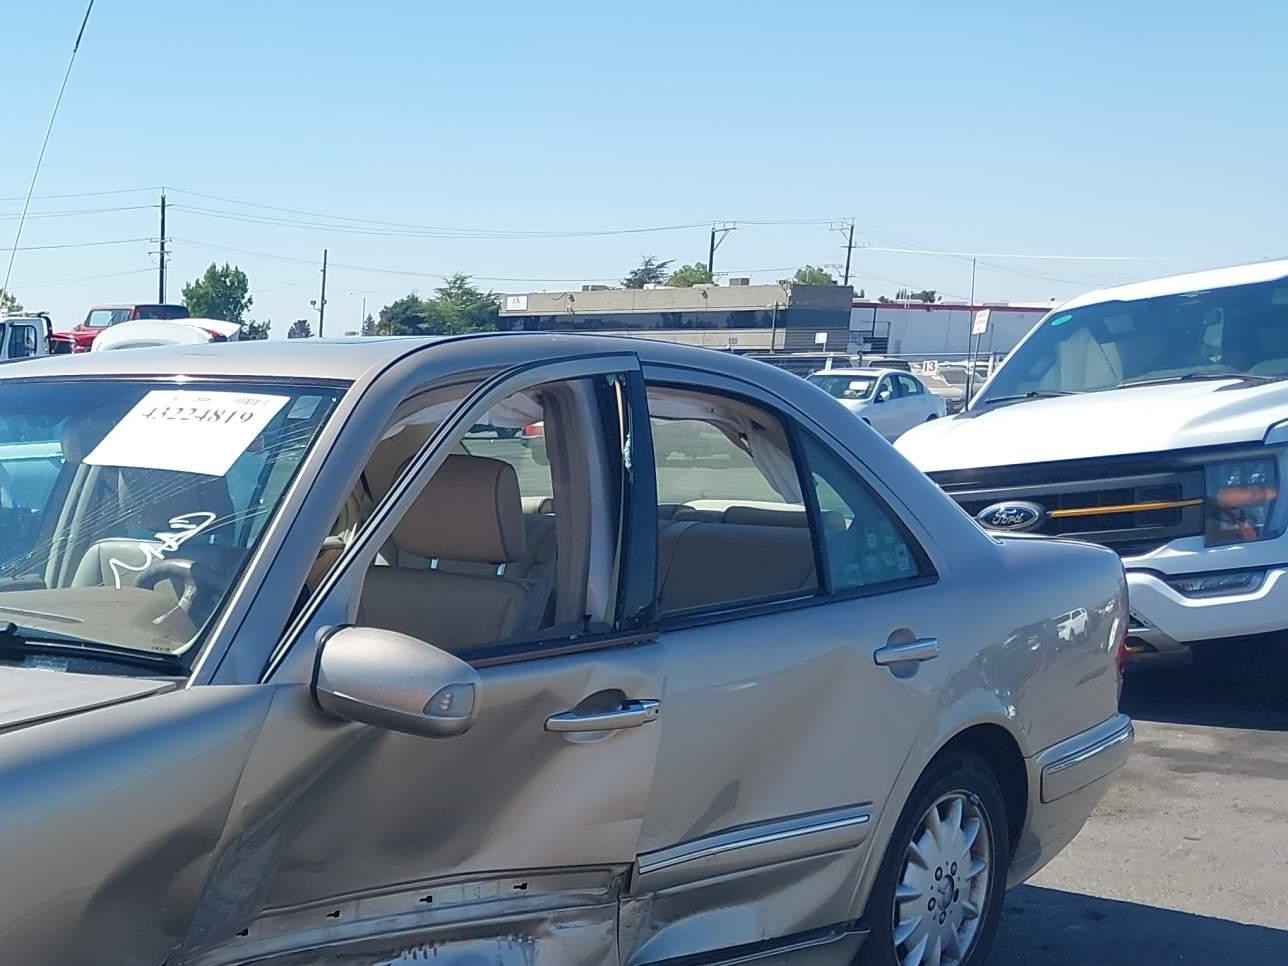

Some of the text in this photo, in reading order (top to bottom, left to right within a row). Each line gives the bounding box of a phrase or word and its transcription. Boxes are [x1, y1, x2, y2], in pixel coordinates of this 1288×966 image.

[924, 361, 936, 372] 13
[141, 406, 255, 424] 43224819
[992, 508, 1025, 525] Ford
